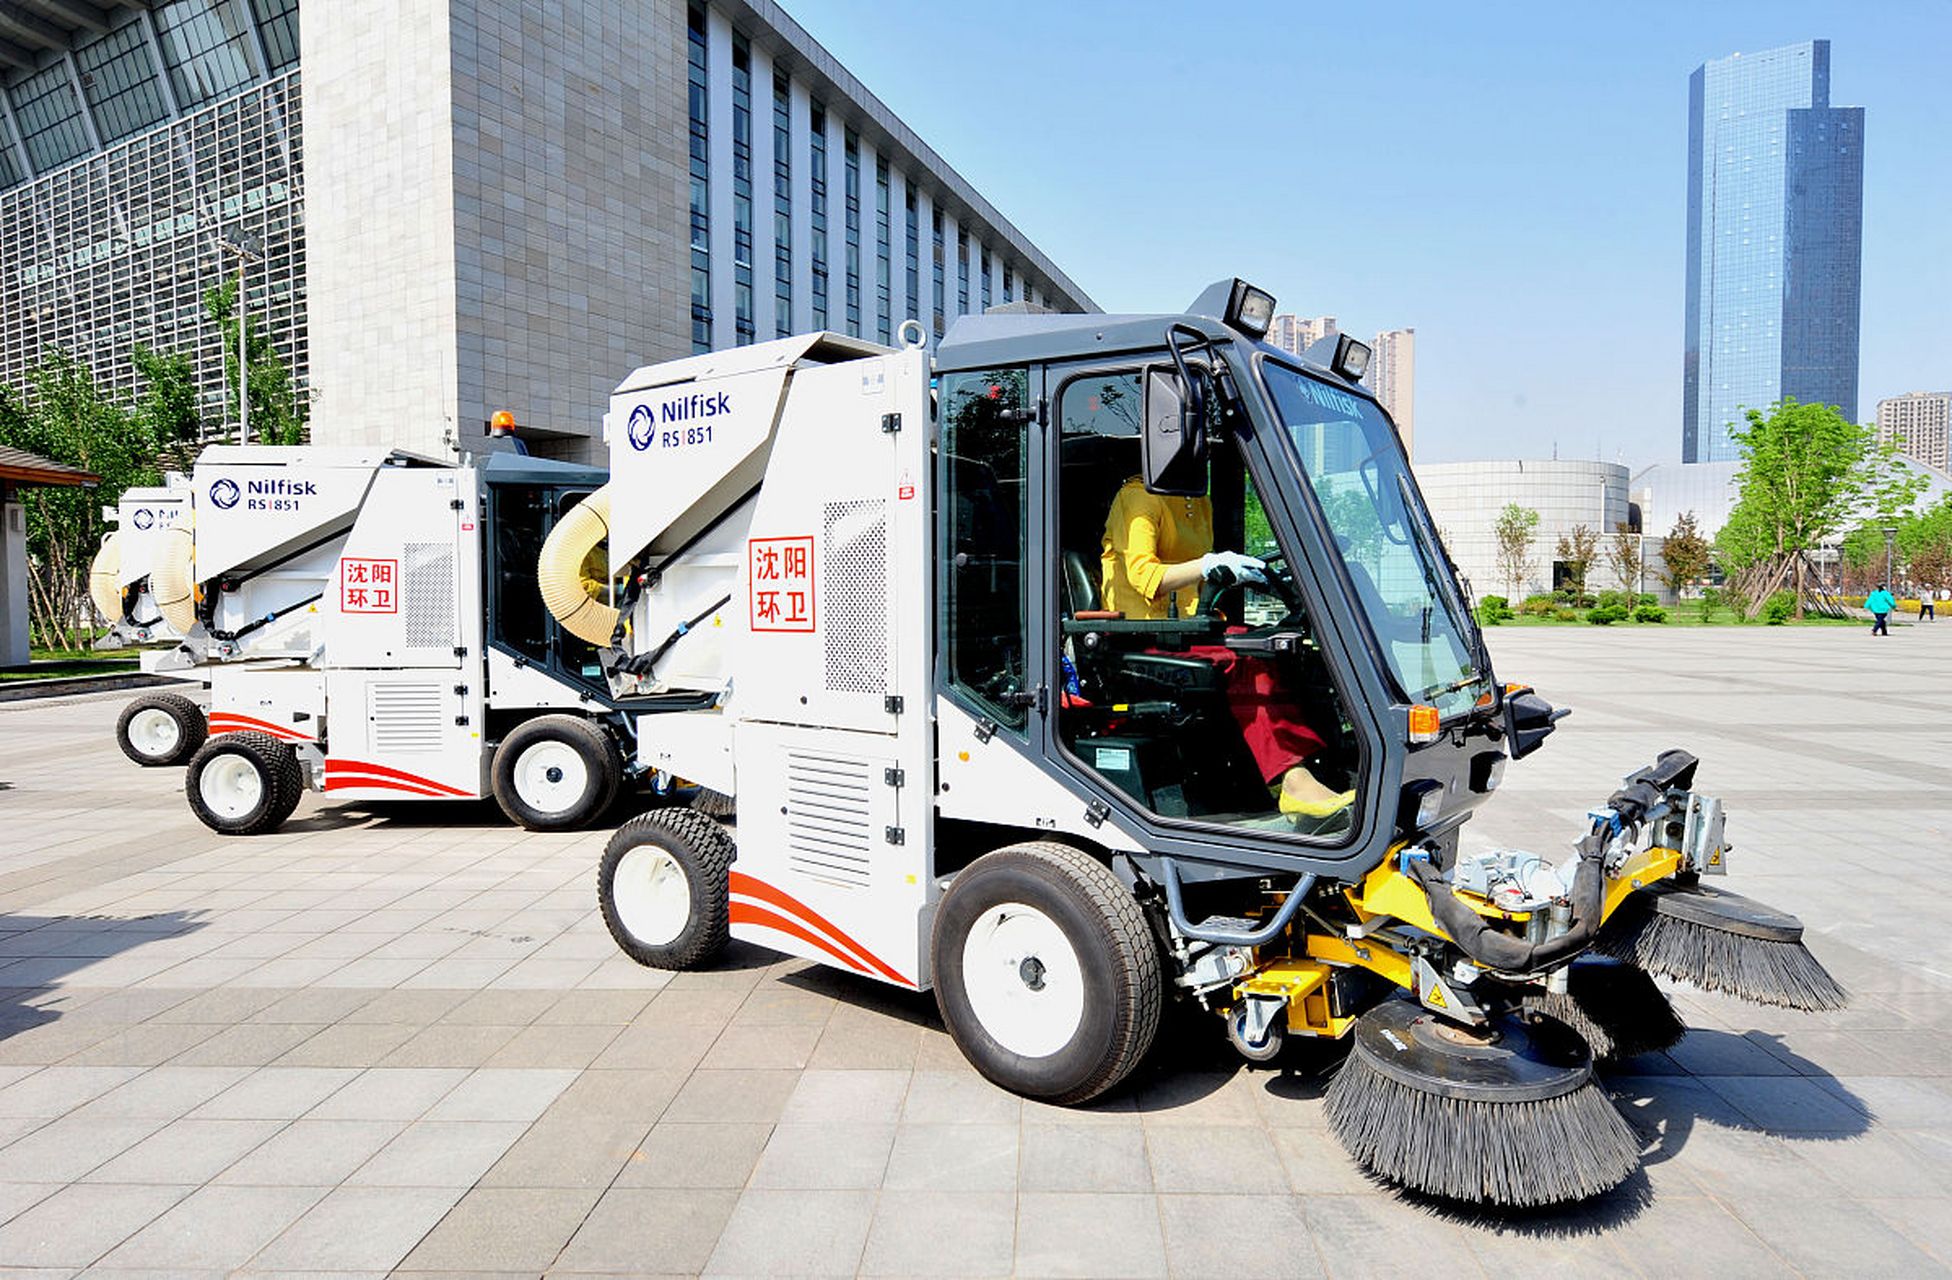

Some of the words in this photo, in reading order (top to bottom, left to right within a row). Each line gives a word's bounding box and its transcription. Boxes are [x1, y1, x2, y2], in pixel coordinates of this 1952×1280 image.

[662, 391, 731, 423] Nilfisk
[1308, 381, 1363, 419] Nilfisk
[248, 479, 318, 495] Nilfisk
[347, 563, 391, 583] 沈阳
[756, 546, 806, 580] 沈阳
[347, 588, 391, 608] 环卫
[756, 591, 808, 623] 环卫
